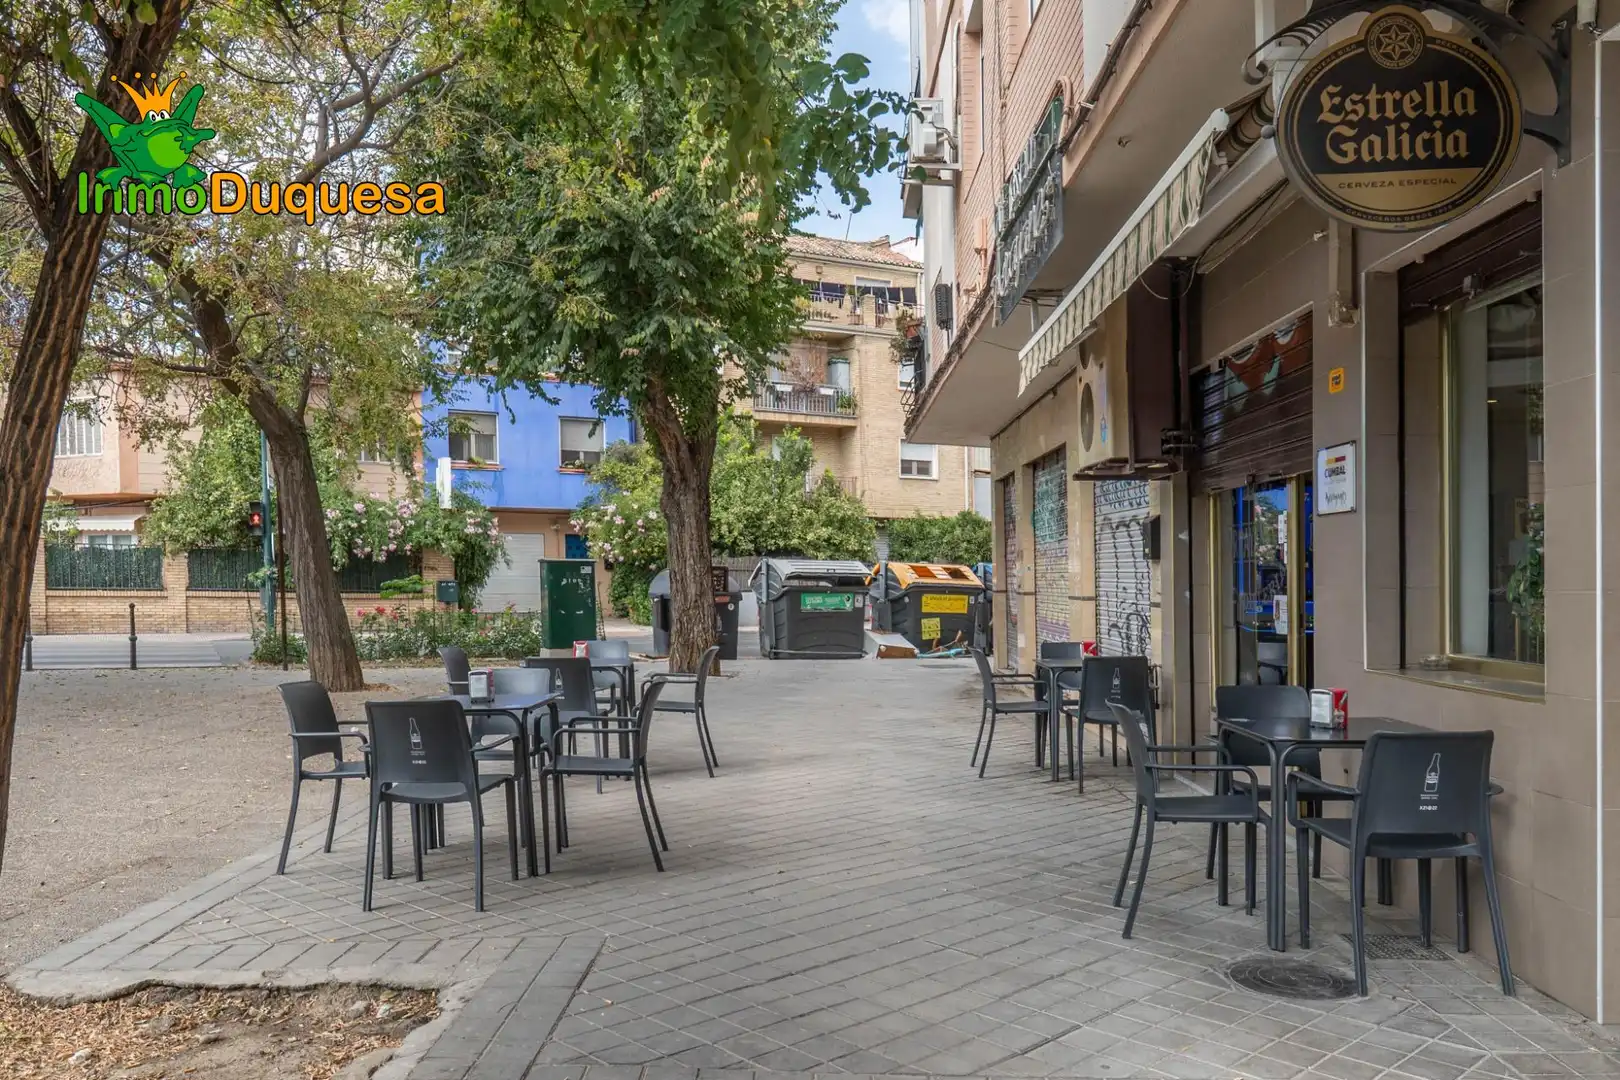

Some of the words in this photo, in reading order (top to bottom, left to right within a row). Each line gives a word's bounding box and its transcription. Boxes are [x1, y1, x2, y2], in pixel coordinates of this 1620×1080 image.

[1316, 79, 1478, 124] Estrella
[1325, 119, 1471, 164] Galicia
[1338, 181, 1395, 189] CERVEZA
[1398, 178, 1457, 187] ESPECIAL
